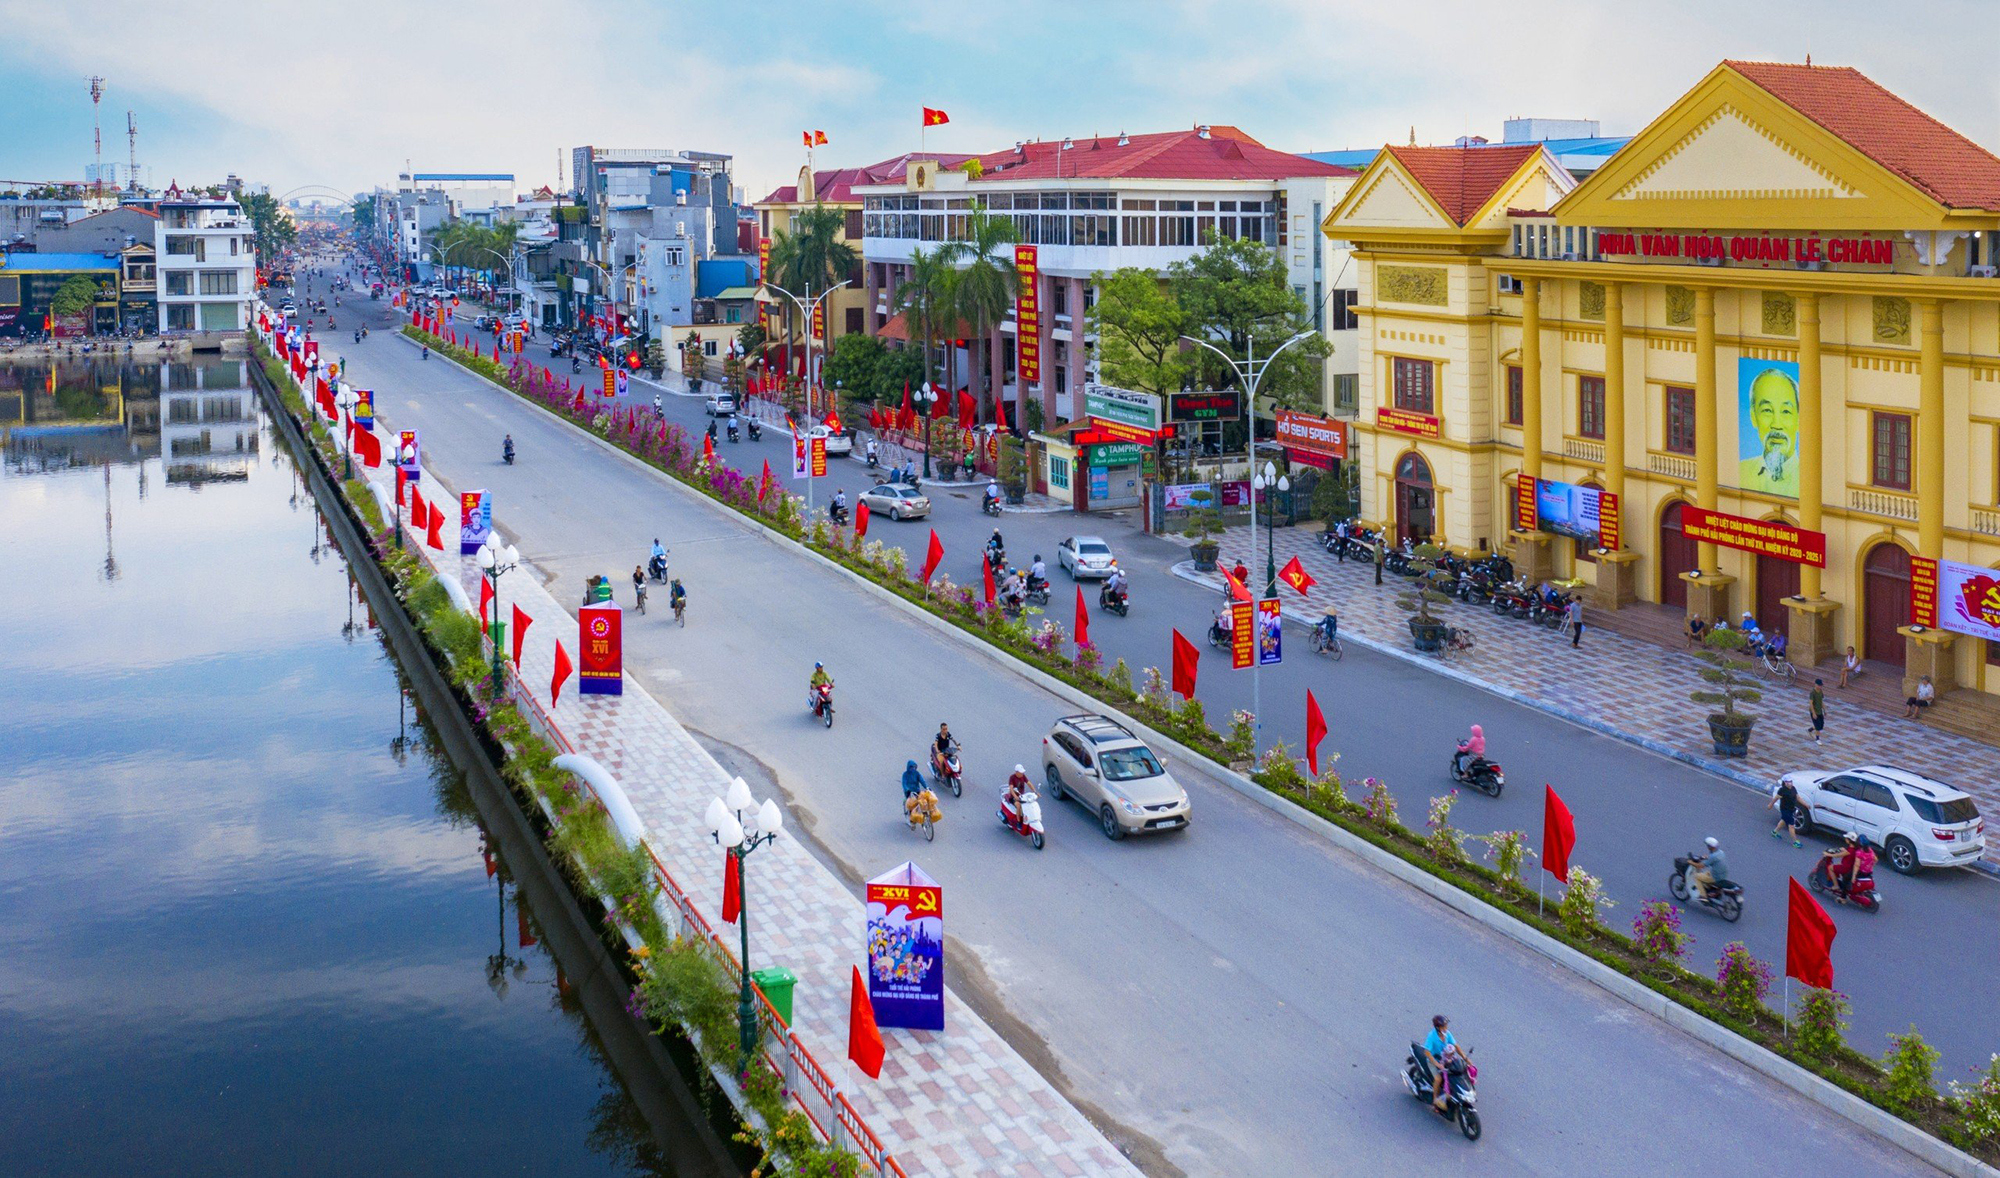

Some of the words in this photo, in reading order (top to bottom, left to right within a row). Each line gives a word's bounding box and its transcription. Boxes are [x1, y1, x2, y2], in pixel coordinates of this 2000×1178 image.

[1599, 228, 1636, 255] NHÀ
[1641, 228, 1679, 256] VĂN
[1684, 229, 1725, 260] HÓA
[1731, 230, 1788, 267] QUẬN
[1795, 230, 1821, 261] LÊ
[1828, 231, 1892, 264] CHÂN
[1194, 409, 1217, 417] GYM
[1277, 415, 1290, 434] HỒ
[1291, 423, 1308, 438] SEN
[1309, 427, 1341, 444] SPORTS
[1705, 515, 1719, 528] NHIỆT
[1719, 517, 1729, 529] LIỆT
[1730, 519, 1743, 532] CHÀO
[1743, 522, 1758, 534] MỪNG
[1776, 528, 1791, 541] ĐẢNG
[1791, 532, 1799, 544] BỘ
[1700, 526, 1710, 538] PHỐ
[1719, 532, 1735, 544] PHÒNG
[1735, 533, 1745, 546] LẦN
[1745, 537, 1755, 548] THỨ
[1765, 542, 1781, 555] NHIỆM
[1982, 612, 2000, 624] XV
[592, 643, 609, 654] XVI
[882, 887, 909, 898] XVI
